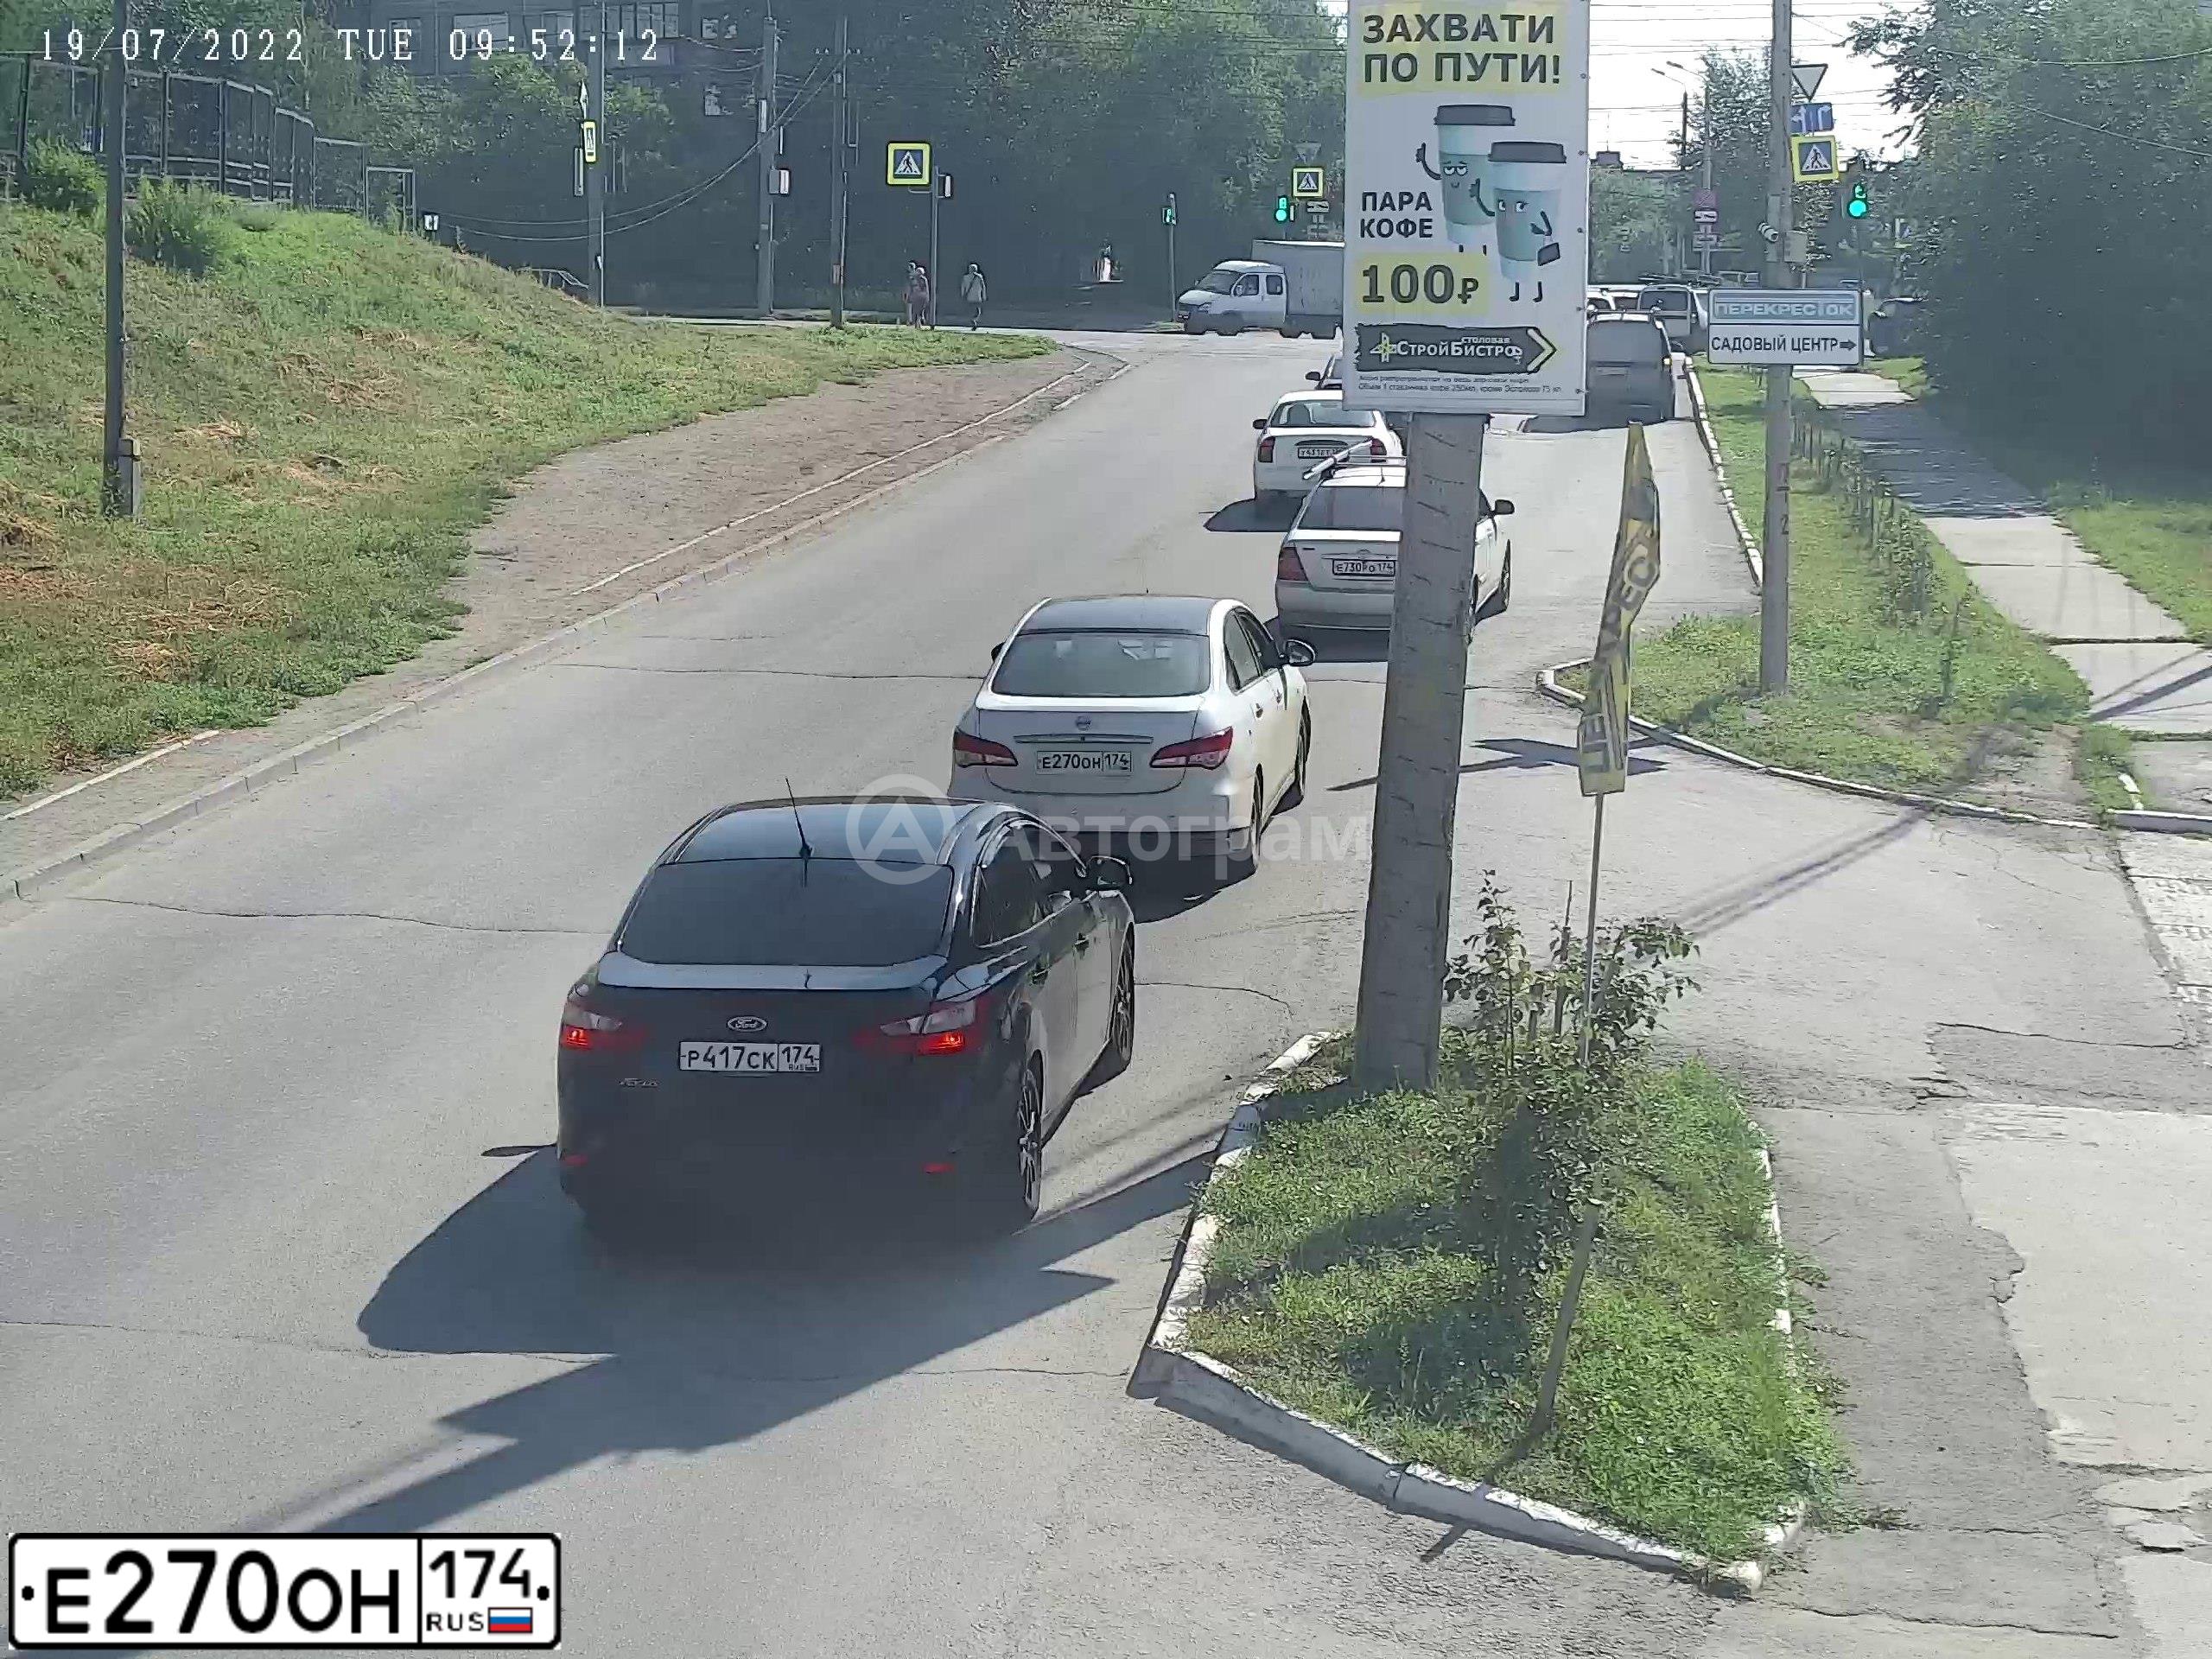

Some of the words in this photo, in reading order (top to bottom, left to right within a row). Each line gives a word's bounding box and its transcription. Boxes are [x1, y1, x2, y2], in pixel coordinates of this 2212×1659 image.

[1363, 14, 1554, 43] ЗАХВАТИ
[1363, 52, 1419, 83] ПО
[1434, 52, 1560, 84] ПУТИ!
[1361, 191, 1433, 212] ПАРА
[1359, 218, 1433, 238] КОФЕ
[1715, 302, 1853, 316] ПЕРЕКРЕСТОК
[1711, 334, 1786, 353] САДОВЫЙ
[1791, 337, 1839, 353] ЦЕНТР
[1042, 753, 1101, 769] Е270ОН
[1105, 753, 1128, 766] 174
[688, 1046, 775, 1069] Р417СК
[782, 1046, 815, 1064] 174
